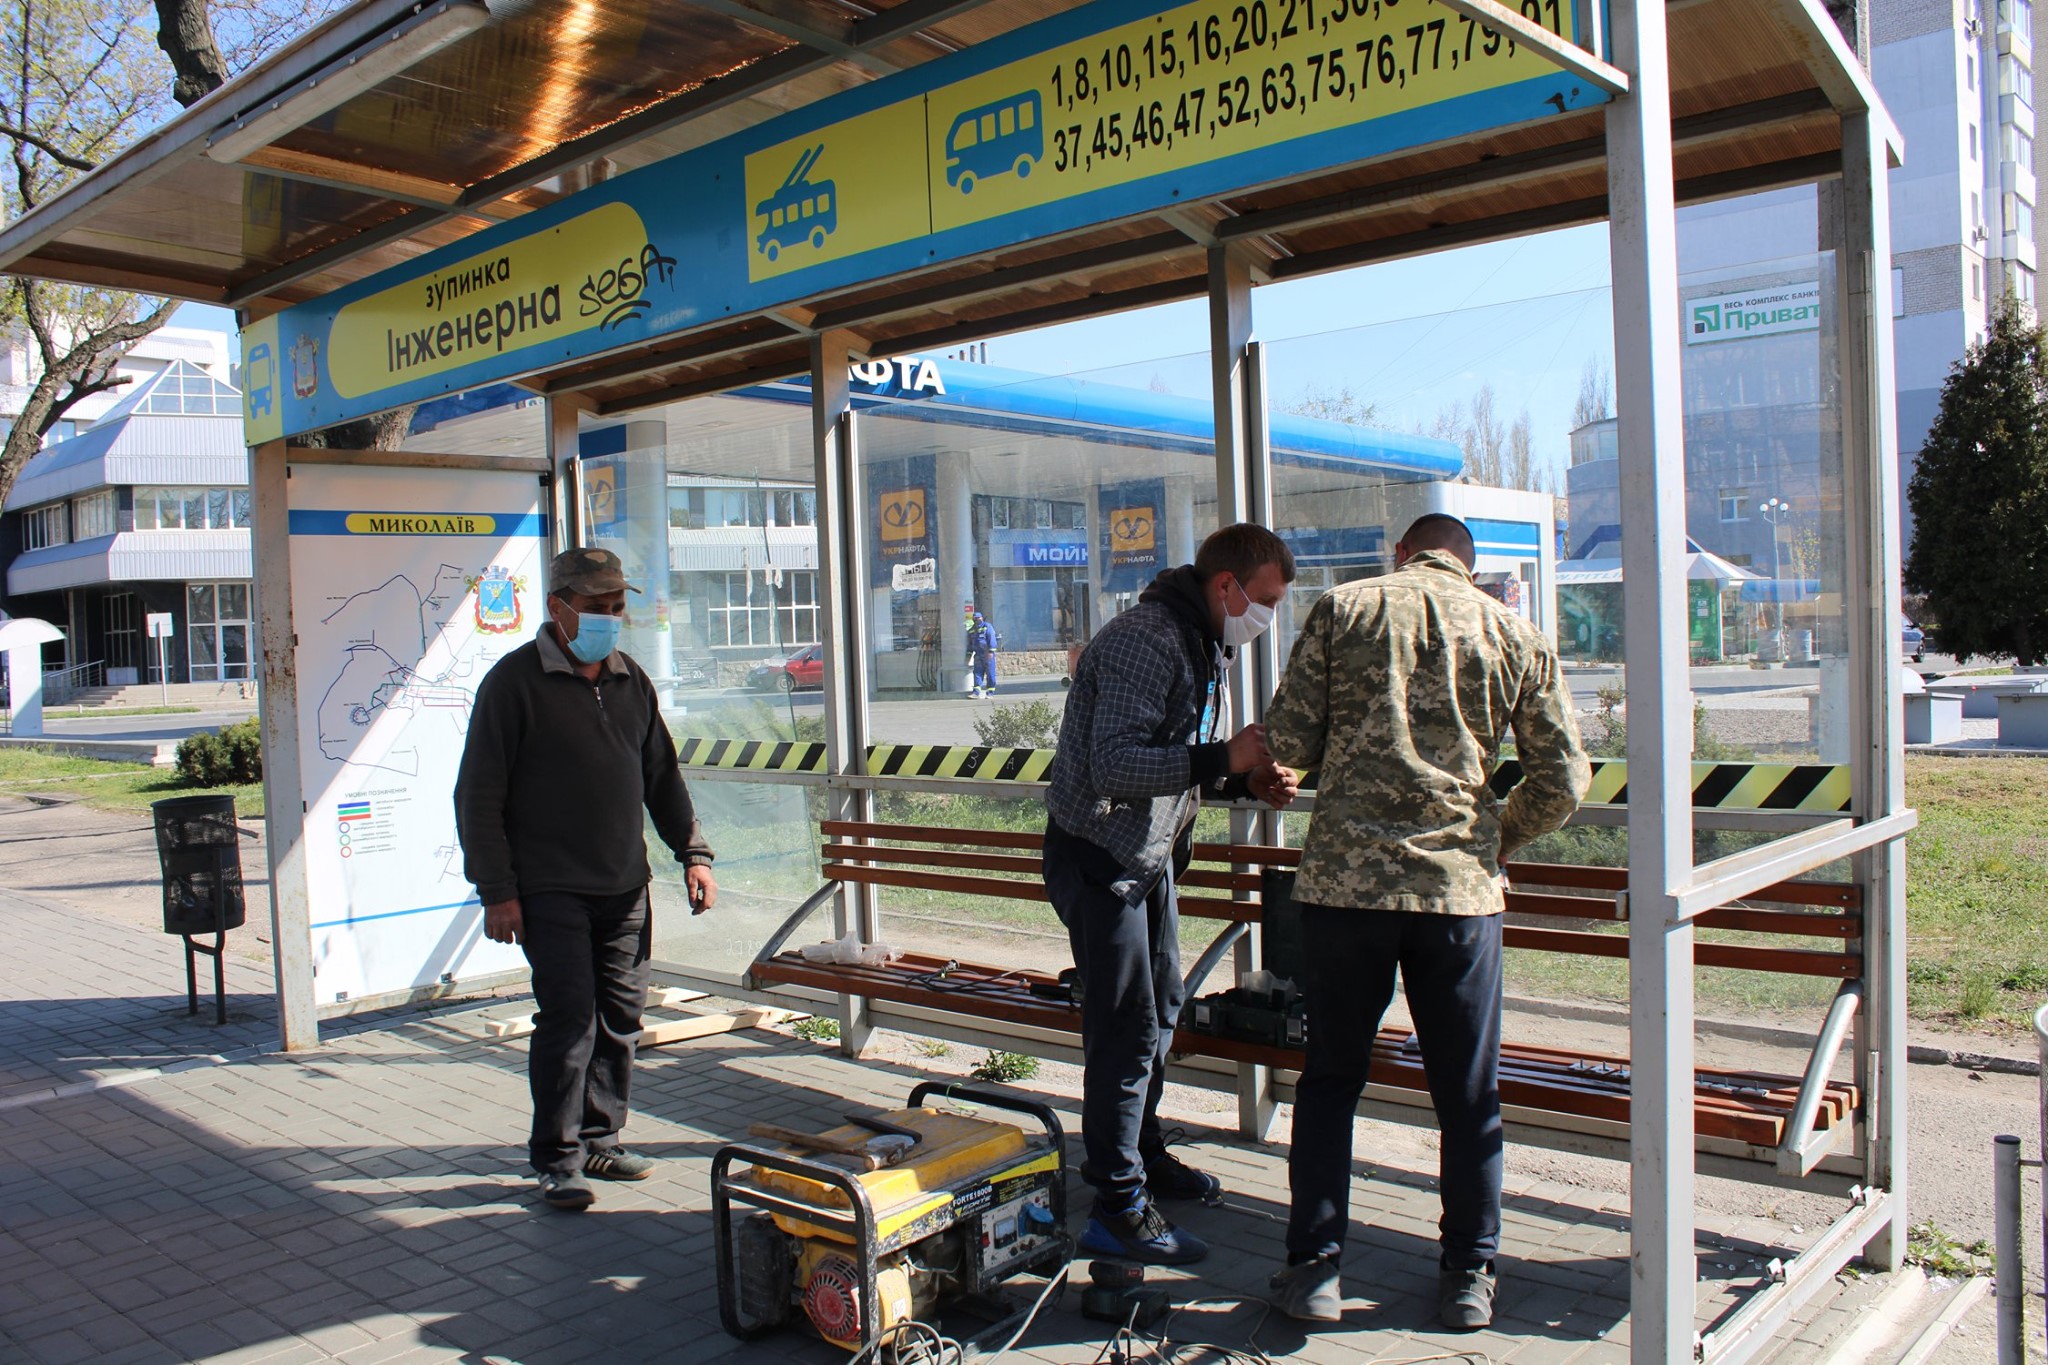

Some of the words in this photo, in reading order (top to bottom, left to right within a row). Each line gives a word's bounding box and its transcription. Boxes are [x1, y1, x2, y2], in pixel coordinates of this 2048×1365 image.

[425, 256, 510, 311] зупинка
[1724, 301, 1744, 310] ВЕСЬ
[1745, 293, 1790, 307] КОМПЛЕКС
[387, 284, 561, 373] Інженерна
[848, 356, 946, 395] ФТА
[369, 517, 475, 533] МИКОЛАЇВ
[882, 543, 927, 556] УКРНАФТА
[1112, 554, 1155, 565] УКРНАФТА
